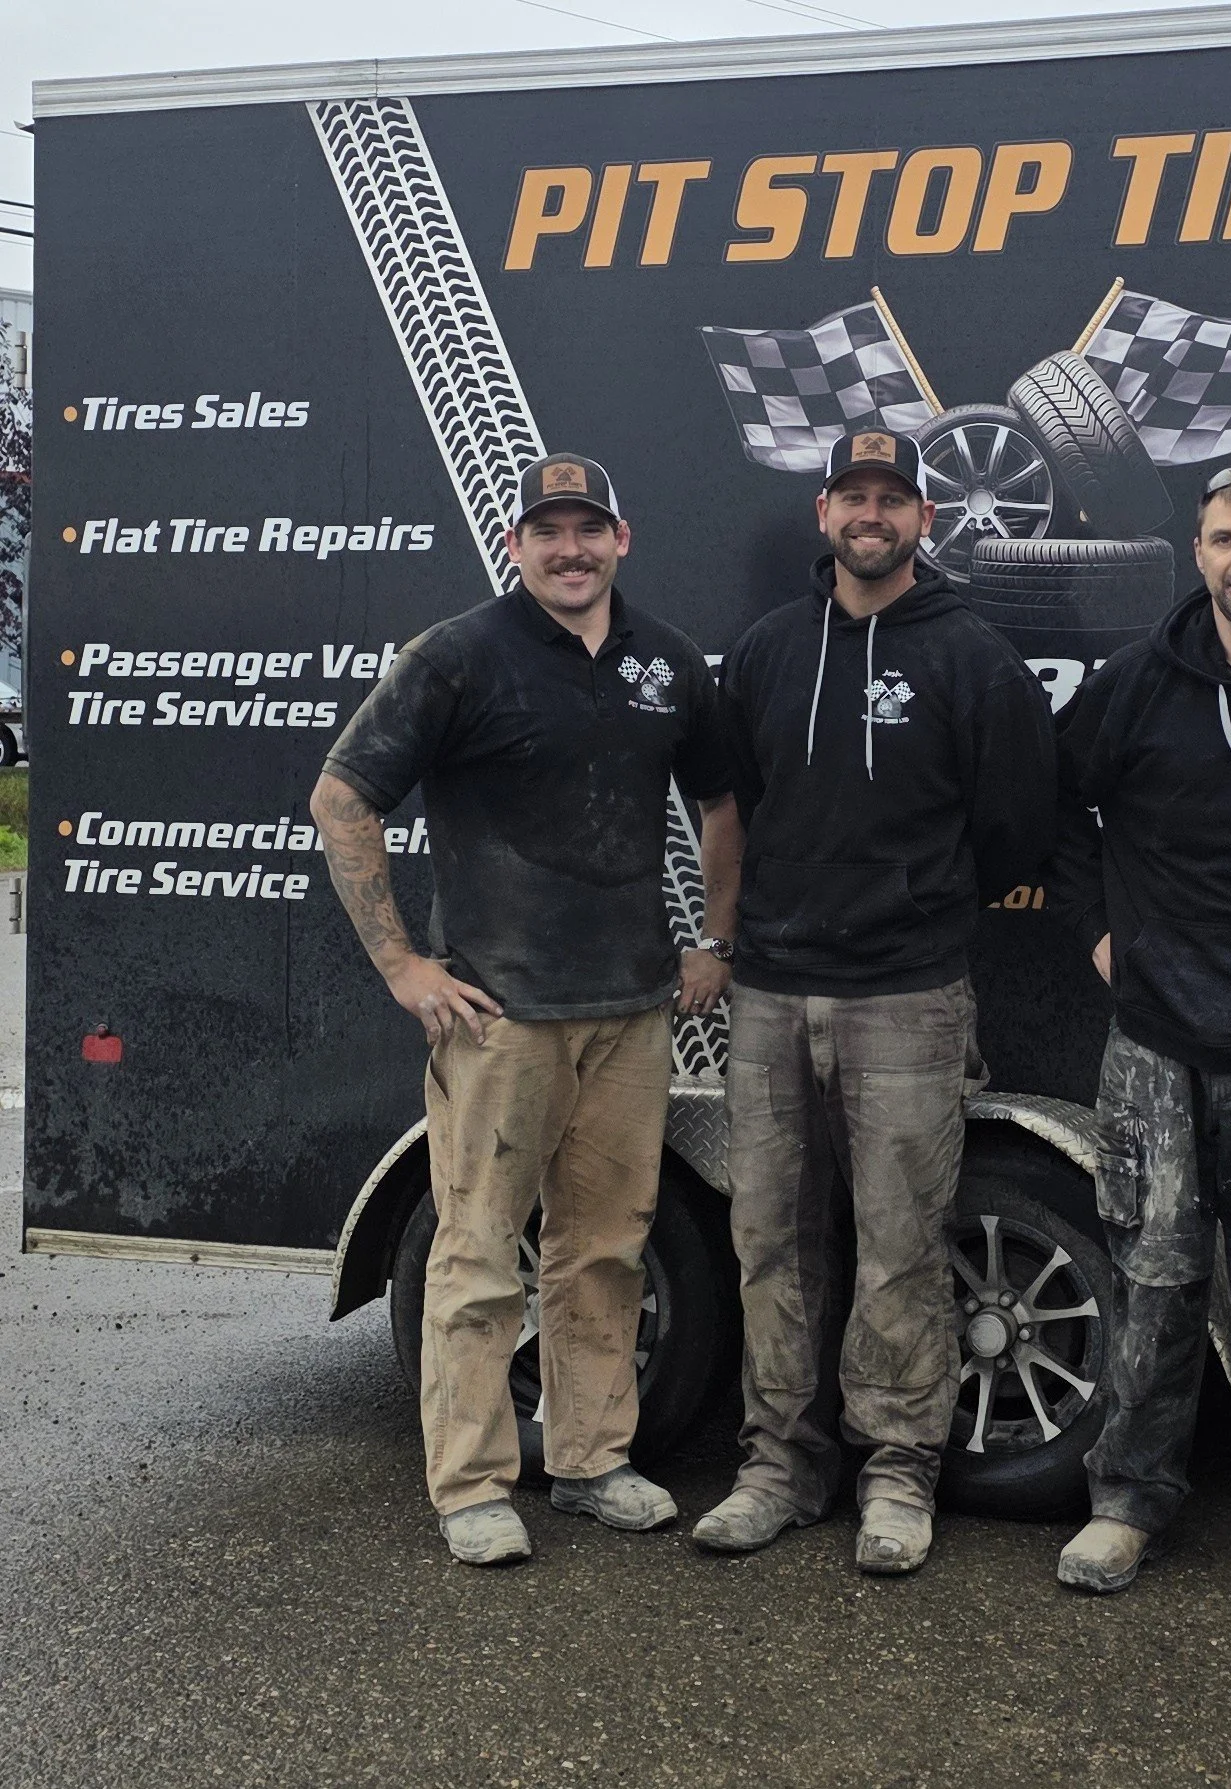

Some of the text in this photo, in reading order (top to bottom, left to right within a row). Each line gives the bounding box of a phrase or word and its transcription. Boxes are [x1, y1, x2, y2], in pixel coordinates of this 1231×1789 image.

[506, 160, 710, 270] PIT
[727, 143, 1071, 261] STOP
[82, 391, 310, 431] Tires Sales
[79, 516, 435, 560] Flat Tire Repairs
[78, 643, 313, 687] Passenger
[67, 691, 338, 728] Tire Services
[64, 859, 310, 899] Tire Service
